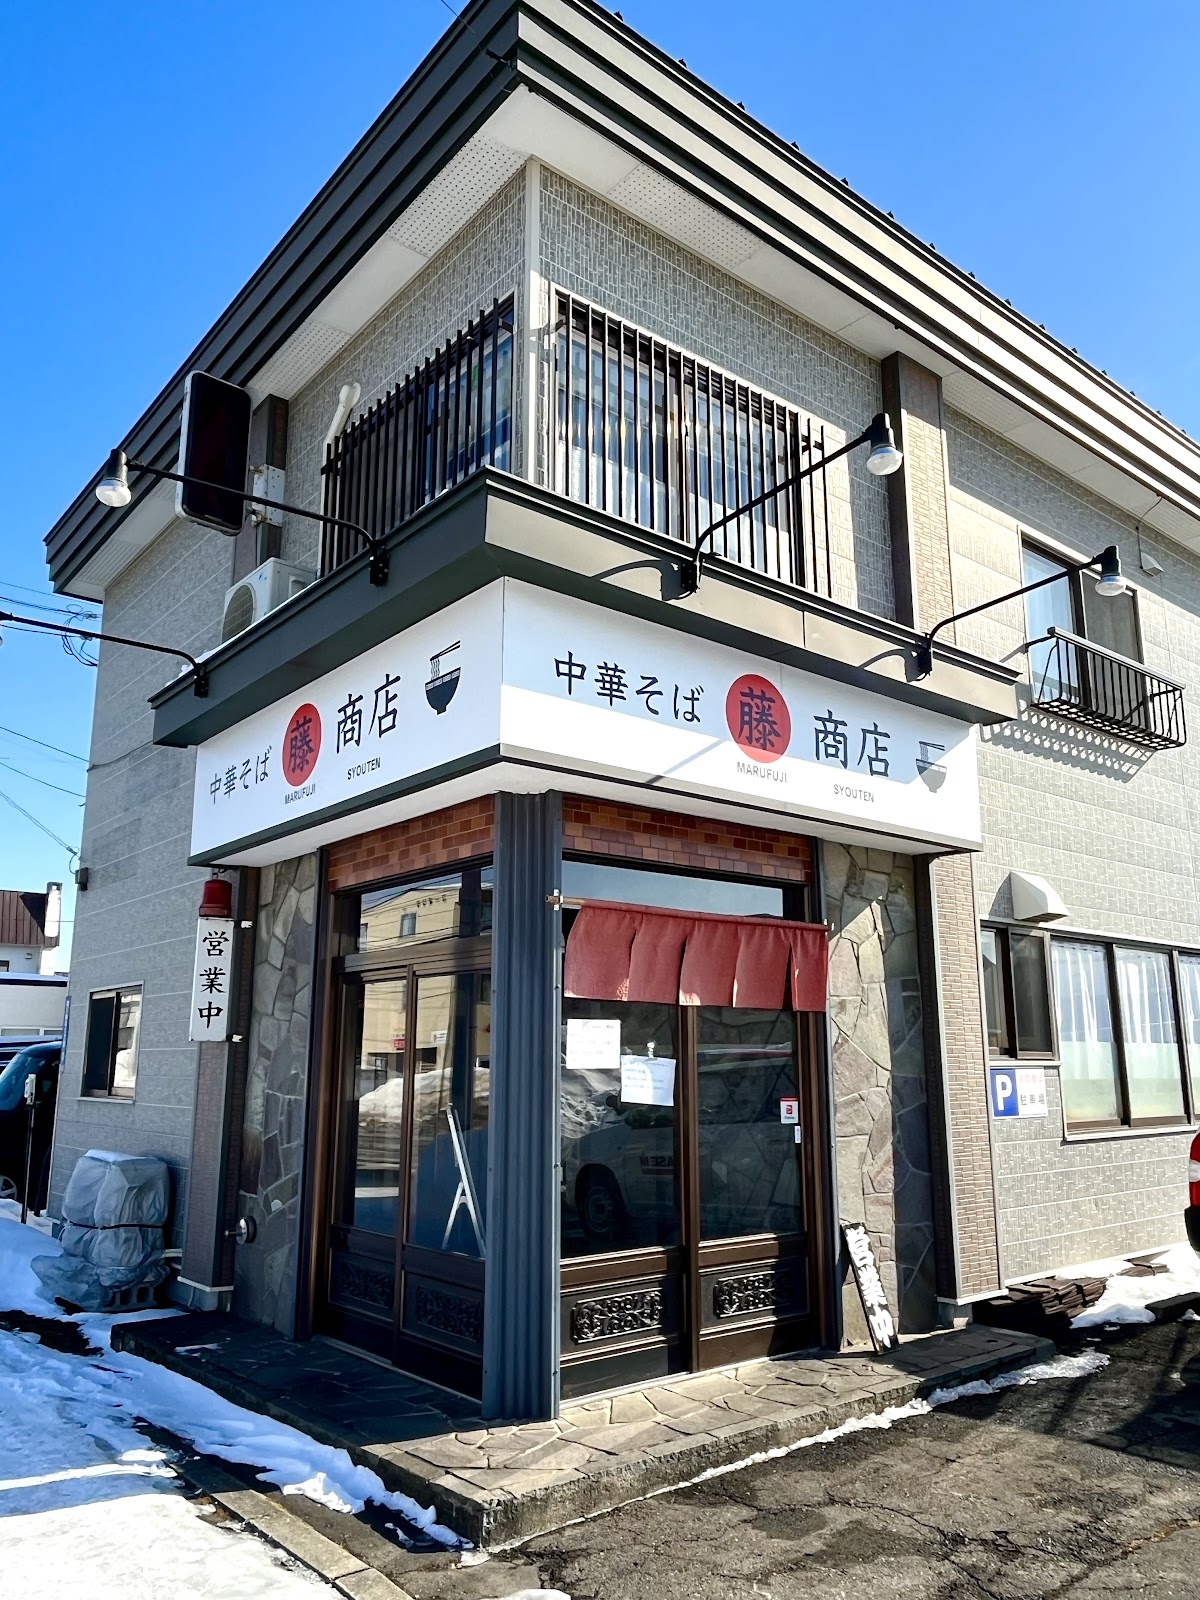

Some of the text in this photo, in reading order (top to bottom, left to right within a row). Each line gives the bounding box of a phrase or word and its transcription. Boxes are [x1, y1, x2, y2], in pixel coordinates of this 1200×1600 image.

[209, 673, 401, 805] 中華そば 藤 商店
[553, 651, 892, 778] 中華そば 藤 商店
[284, 757, 381, 805] MARUFUJI SYOUTEN
[736, 761, 876, 803] MARUFUJI SYOUTEN
[197, 930, 230, 1029] 営業中
[995, 1074, 1013, 1111] P
